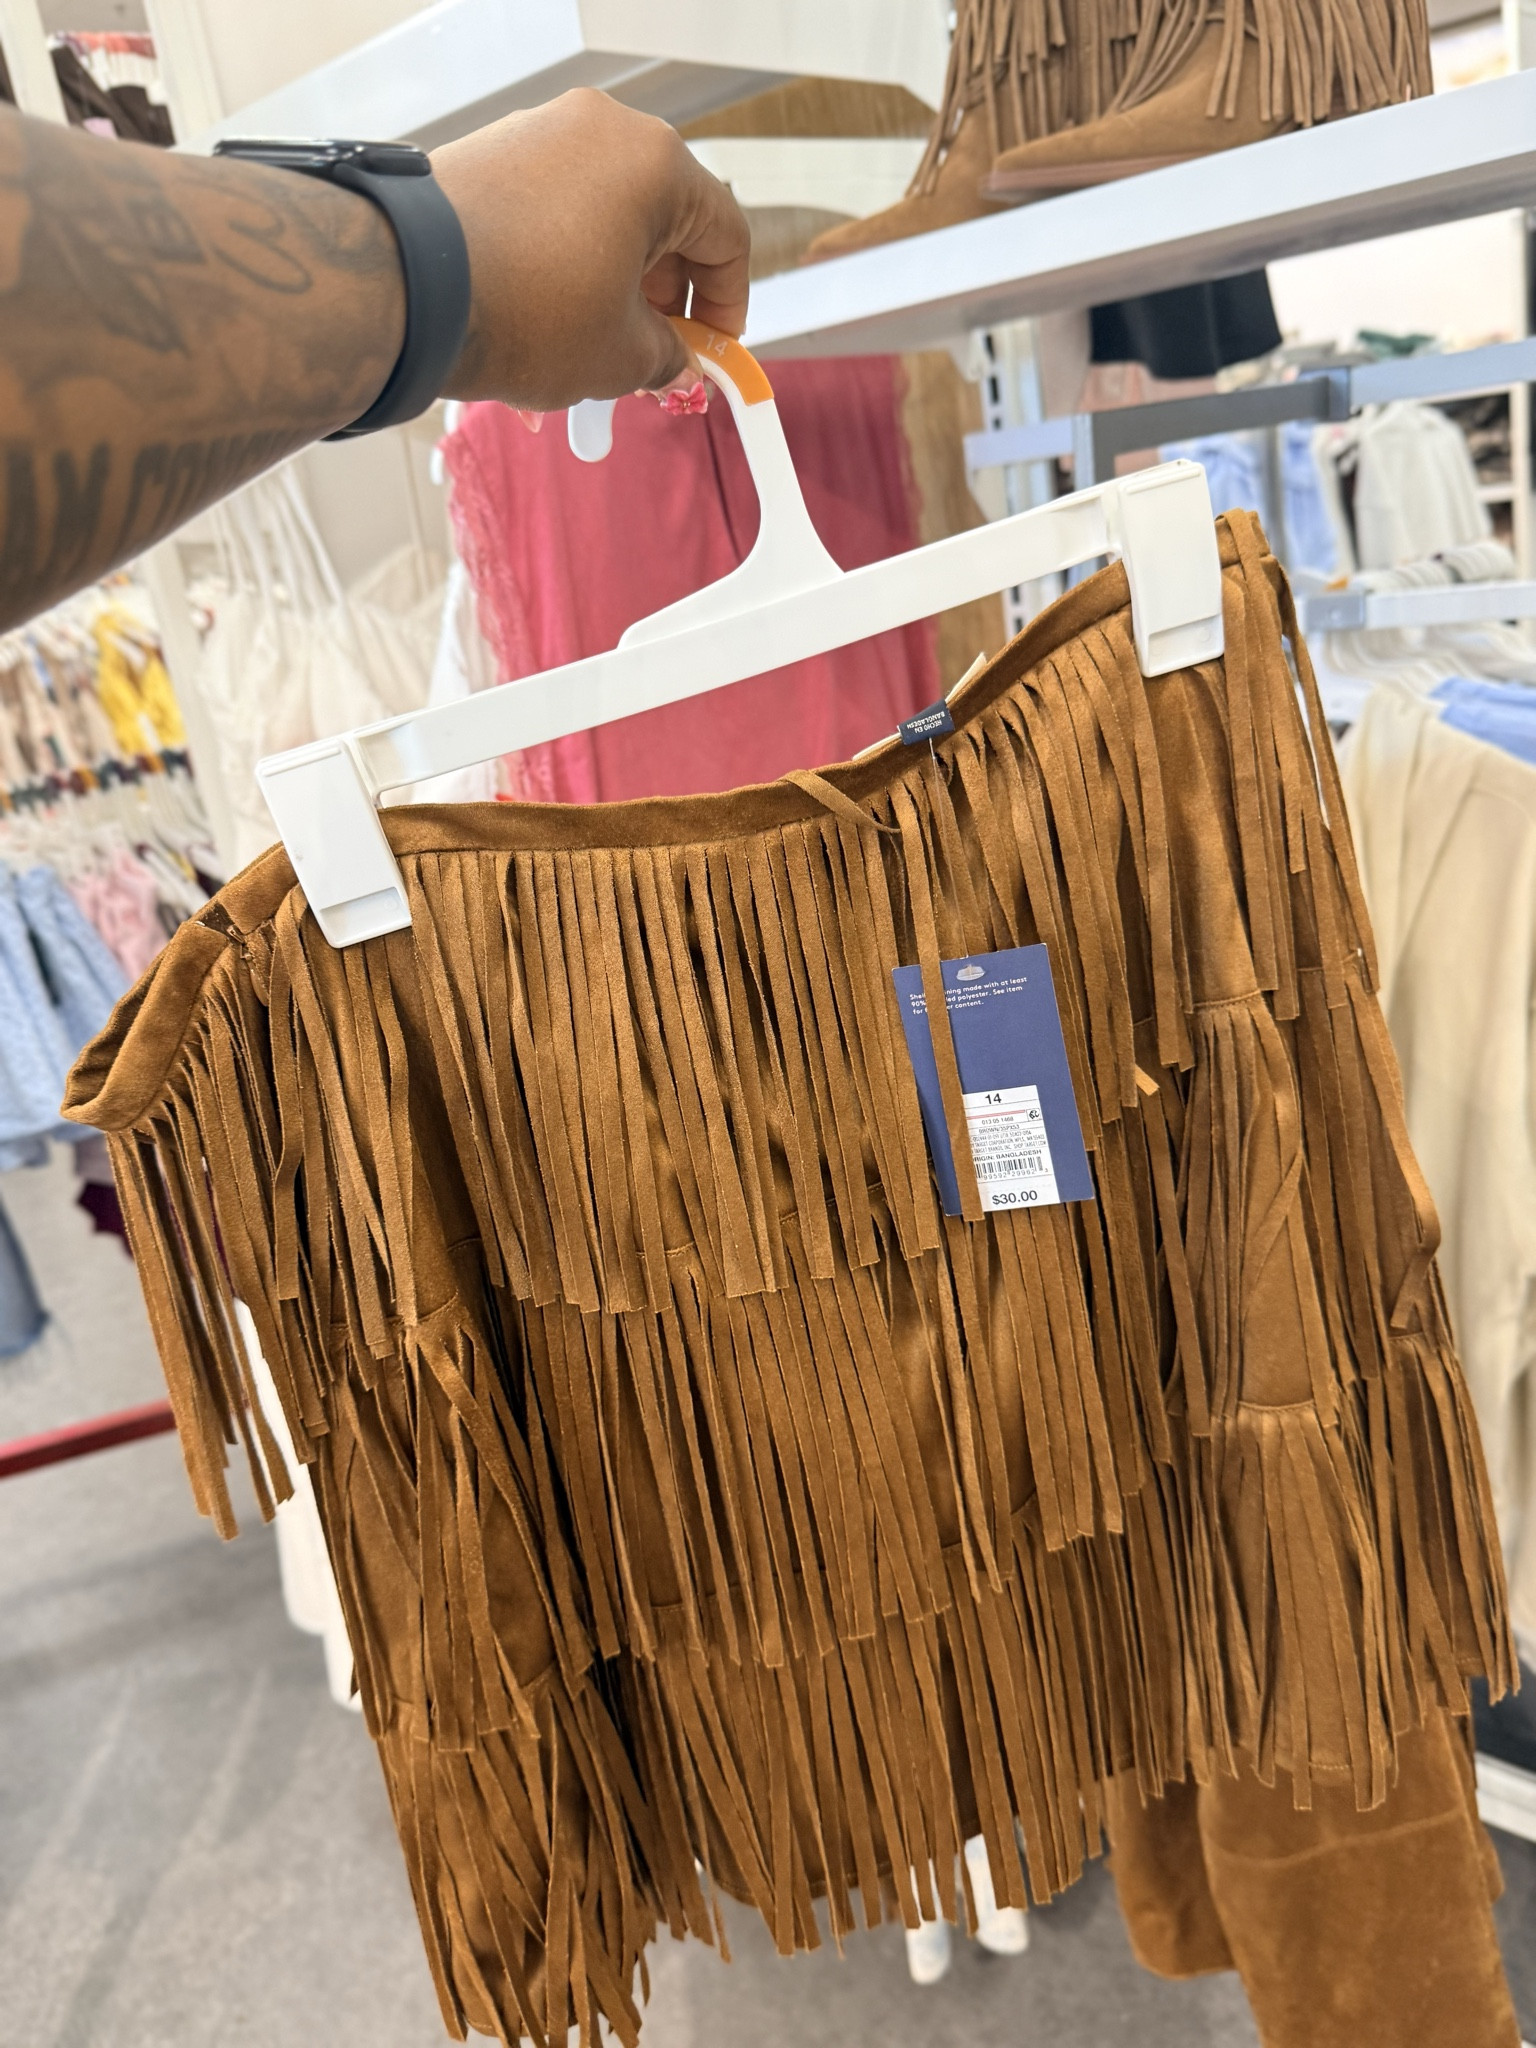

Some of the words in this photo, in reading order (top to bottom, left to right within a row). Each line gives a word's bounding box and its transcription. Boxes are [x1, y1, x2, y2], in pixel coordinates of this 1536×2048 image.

[707, 334, 728, 357] 14
[906, 711, 946, 729] BANGLADESH
[983, 981, 999, 989] with
[1010, 977, 1027, 985] least
[957, 991, 992, 1002] polyester.
[1006, 985, 1023, 993] item
[954, 1001, 984, 1009] content.
[985, 1093, 1002, 1104] 14
[973, 1154, 995, 1162] RIGIN:
[996, 1149, 1042, 1159] BANGLADESH
[992, 1190, 1038, 1205] $30.00
